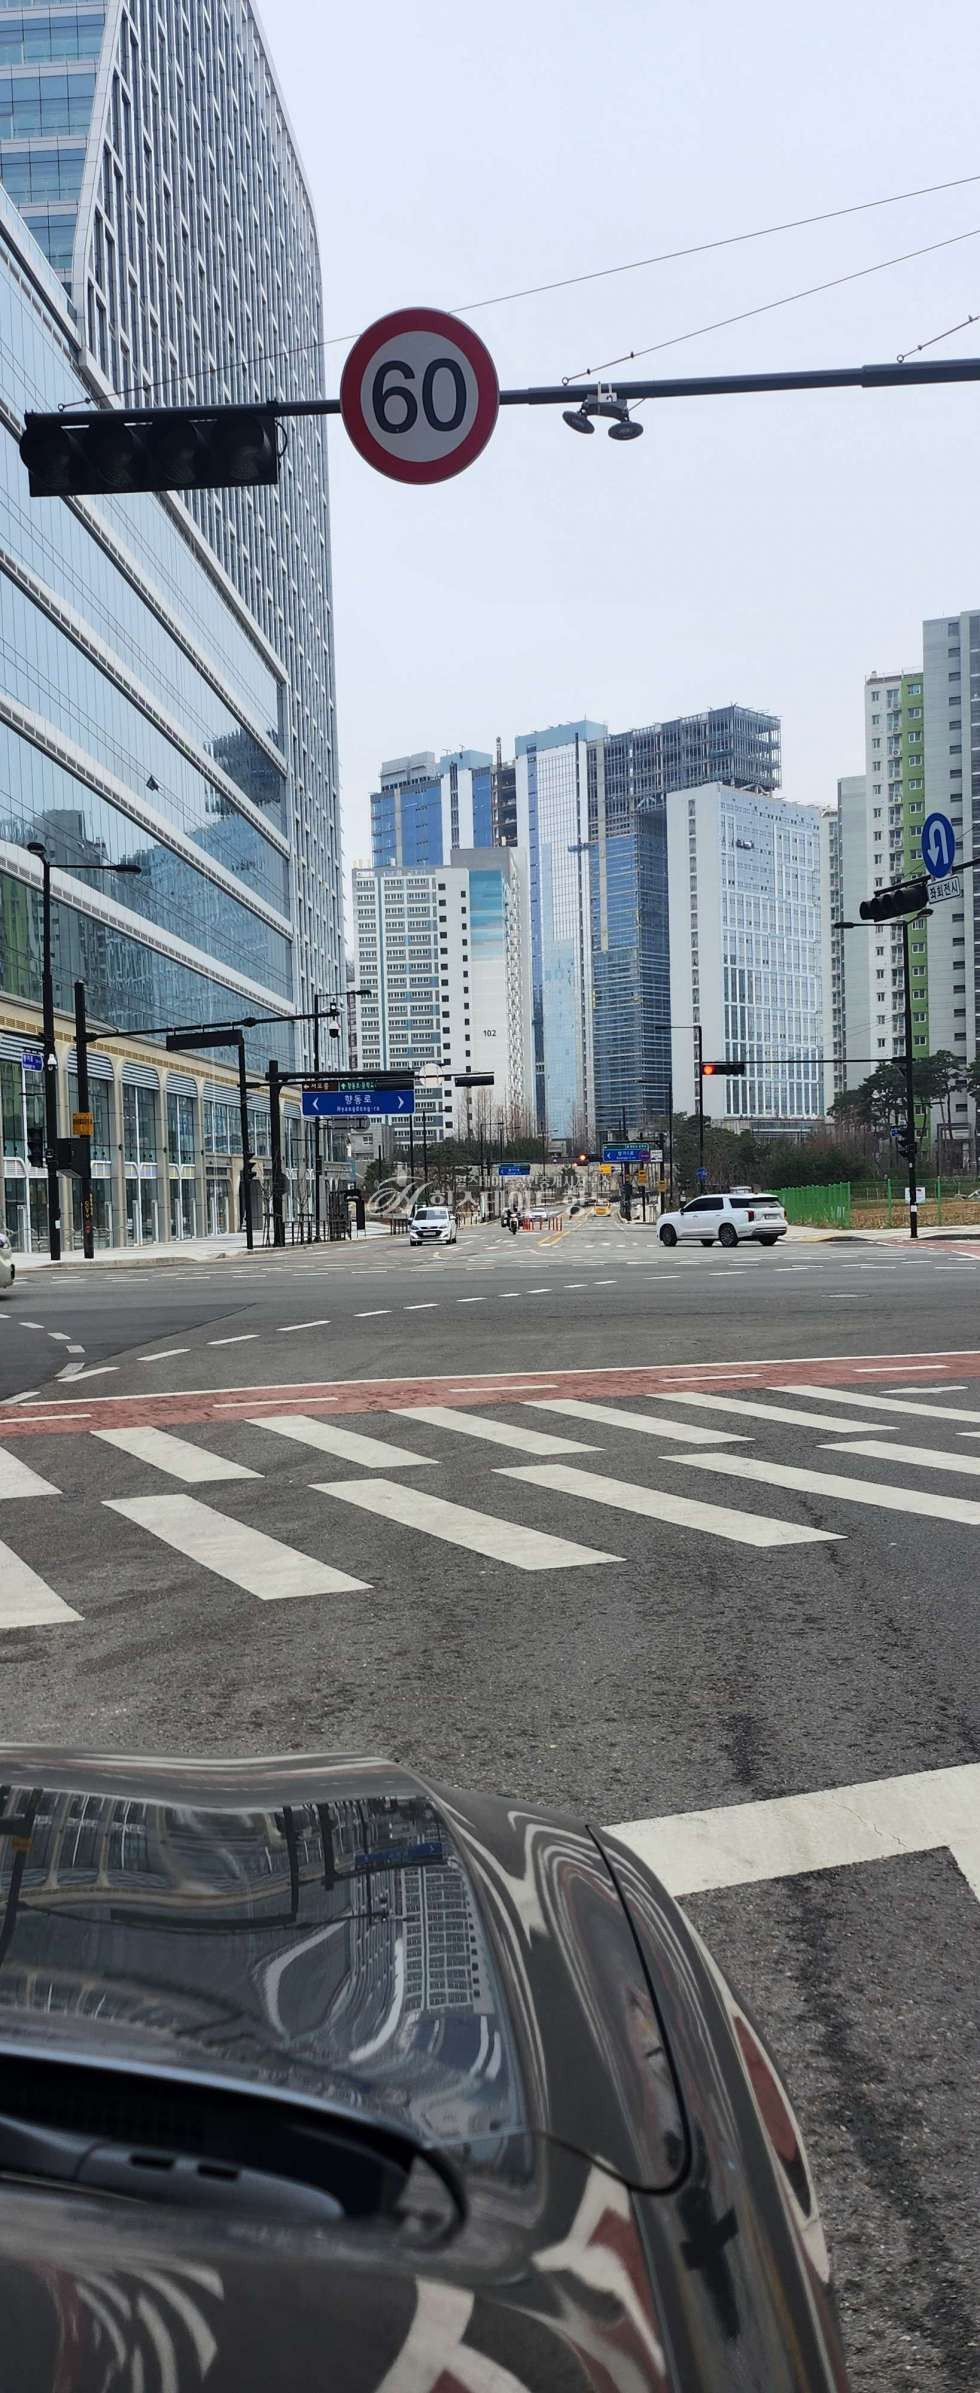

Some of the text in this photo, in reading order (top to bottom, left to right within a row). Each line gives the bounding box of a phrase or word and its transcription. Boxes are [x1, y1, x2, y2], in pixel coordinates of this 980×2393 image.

[371, 357, 467, 435] 60
[930, 880, 958, 899] 좌회전시
[483, 1029, 497, 1037] 102
[344, 1094, 372, 1105] 향동로
